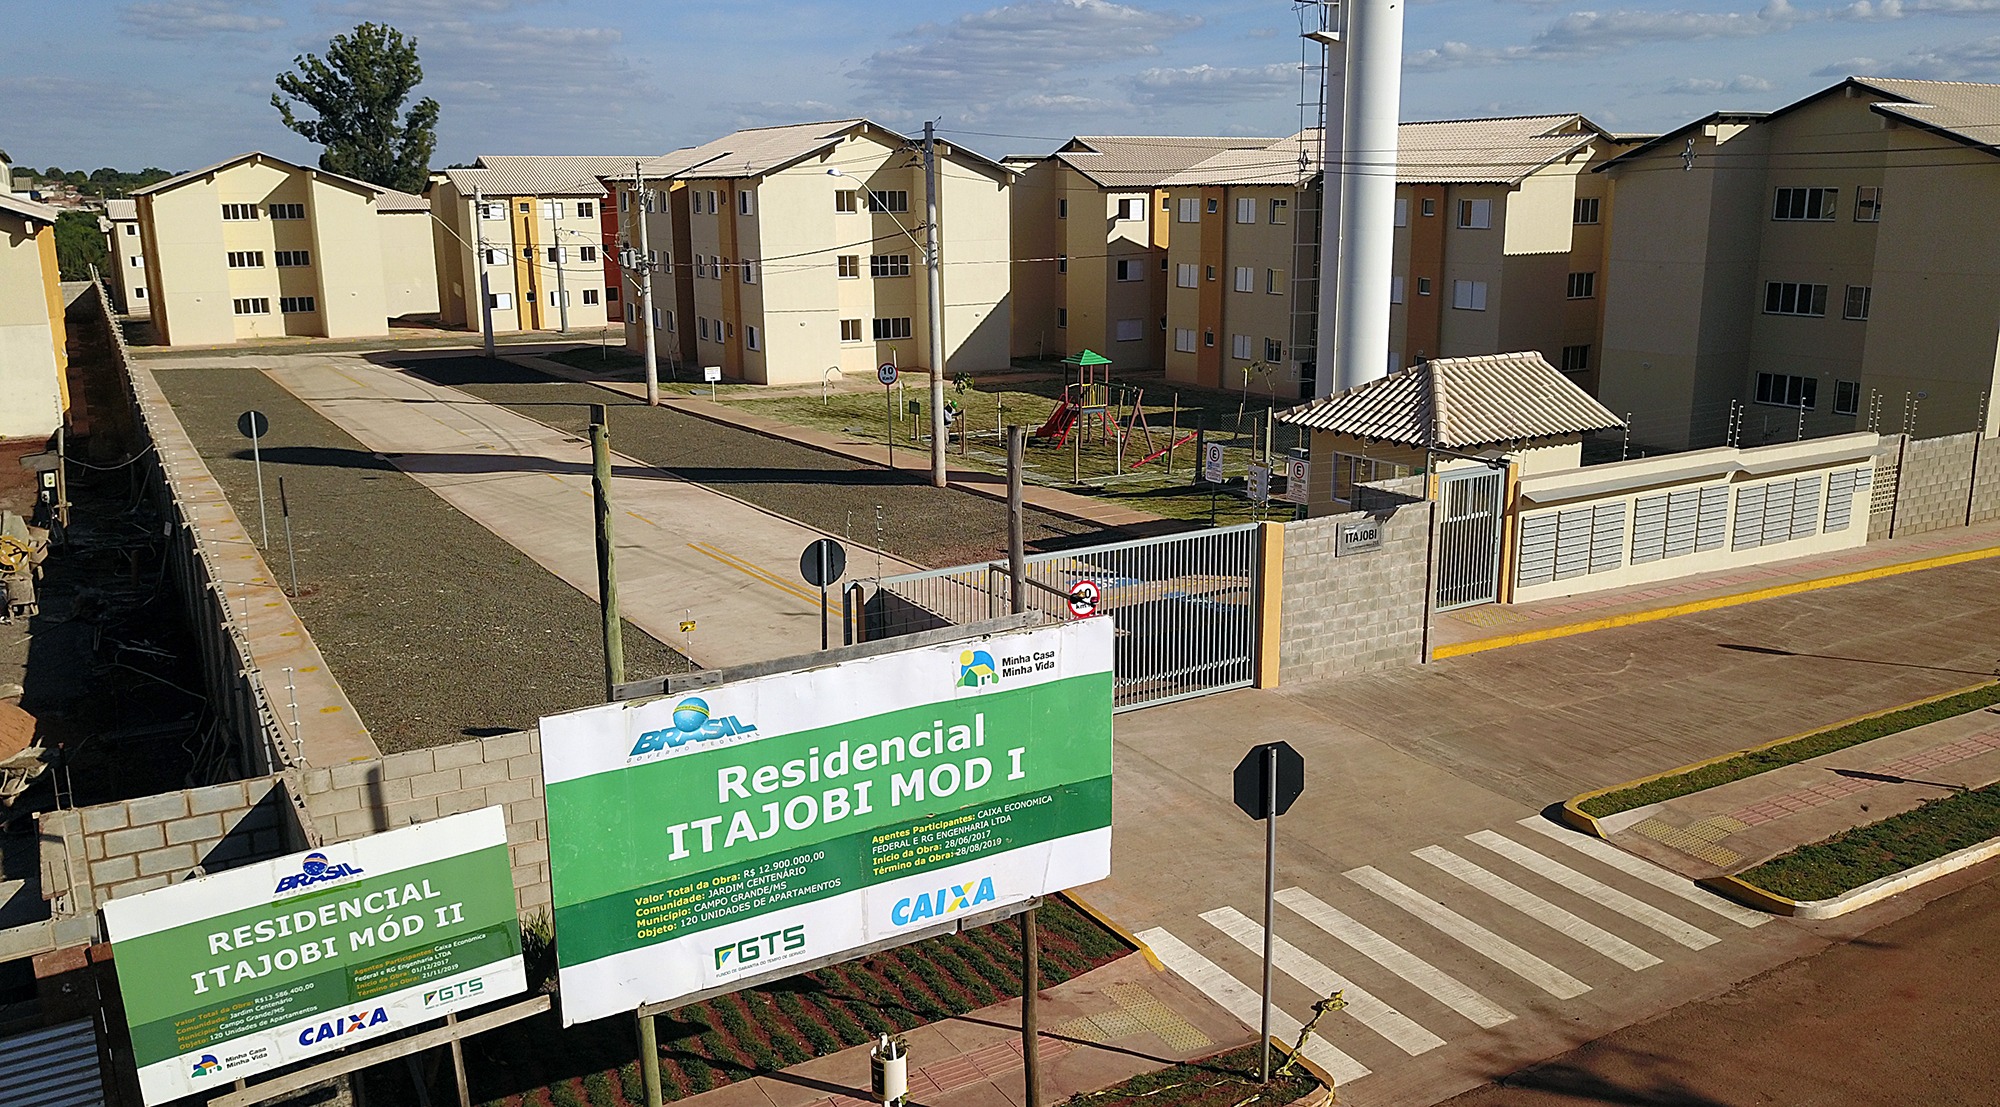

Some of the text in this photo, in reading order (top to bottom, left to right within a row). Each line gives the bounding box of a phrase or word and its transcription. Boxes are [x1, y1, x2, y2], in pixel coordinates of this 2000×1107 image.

[881, 366, 894, 375] 10
[1211, 449, 1218, 460] E
[1296, 465, 1303, 476] E
[1345, 528, 1378, 544] ITAJOBI
[1002, 649, 1055, 667] Minha Casa
[1002, 660, 1055, 678] Minha Vida
[626, 731, 760, 764] GOVERNO FEDERAL
[629, 715, 758, 757] BRASIL
[716, 712, 985, 804] Residencial
[666, 746, 1026, 861] ITAJOBI MOD I
[872, 794, 1053, 845] Agentes Participantes: CAIXA ECONOMICA
[872, 814, 1012, 855] FEDERAL E RG ENGENHARIA LTDA
[872, 829, 991, 866] Início da Obra: 28/06/2017
[872, 837, 1002, 876] Término da Obra: 28/08/2019
[274, 862, 365, 894] BRASIL
[634, 850, 825, 906] Valor Total da Obra: R$ 12.900.000,00
[635, 865, 807, 918] Comunidade: JARDIM CENTENÁRIO
[207, 878, 441, 956] RESIDENCIAL
[636, 880, 787, 928] Município: CAMPO GRANDE/MS
[637, 877, 842, 939] Objeto: 120 UNIDADES DE APARTAMENTOS
[891, 876, 996, 926] CAIXA
[190, 902, 465, 996] ITAJOBI MÓD II
[354, 962, 384, 976] Agentes
[385, 949, 434, 967] Participantes:
[434, 943, 453, 952] Caixa
[714, 924, 805, 971] FGTS
[354, 971, 379, 983] Federal
[386, 966, 397, 974] RG
[397, 956, 434, 971] Engenharia
[434, 950, 452, 960] LTDA
[357, 984, 388, 997] Término
[422, 963, 459, 979] 21/11/2019
[379, 976, 389, 984] da
[411, 958, 449, 974] 01/12/2017
[423, 977, 483, 1006] FGTS
[175, 1017, 196, 1027] Valor
[198, 1009, 219, 1020] Total
[220, 1006, 231, 1014] da
[232, 1000, 254, 1011] Obra:
[176, 996, 293, 1035] Comunidade: Jardim Centenário
[179, 1005, 318, 1050] Objeto: 120 Unidades de Apartamentos
[219, 1019, 245, 1031] Campo
[246, 1006, 286, 1022] Grande/MS
[298, 1006, 389, 1046] CAIXA
[225, 1046, 267, 1063] Minha Casa
[226, 1052, 268, 1069] Minha Vida
